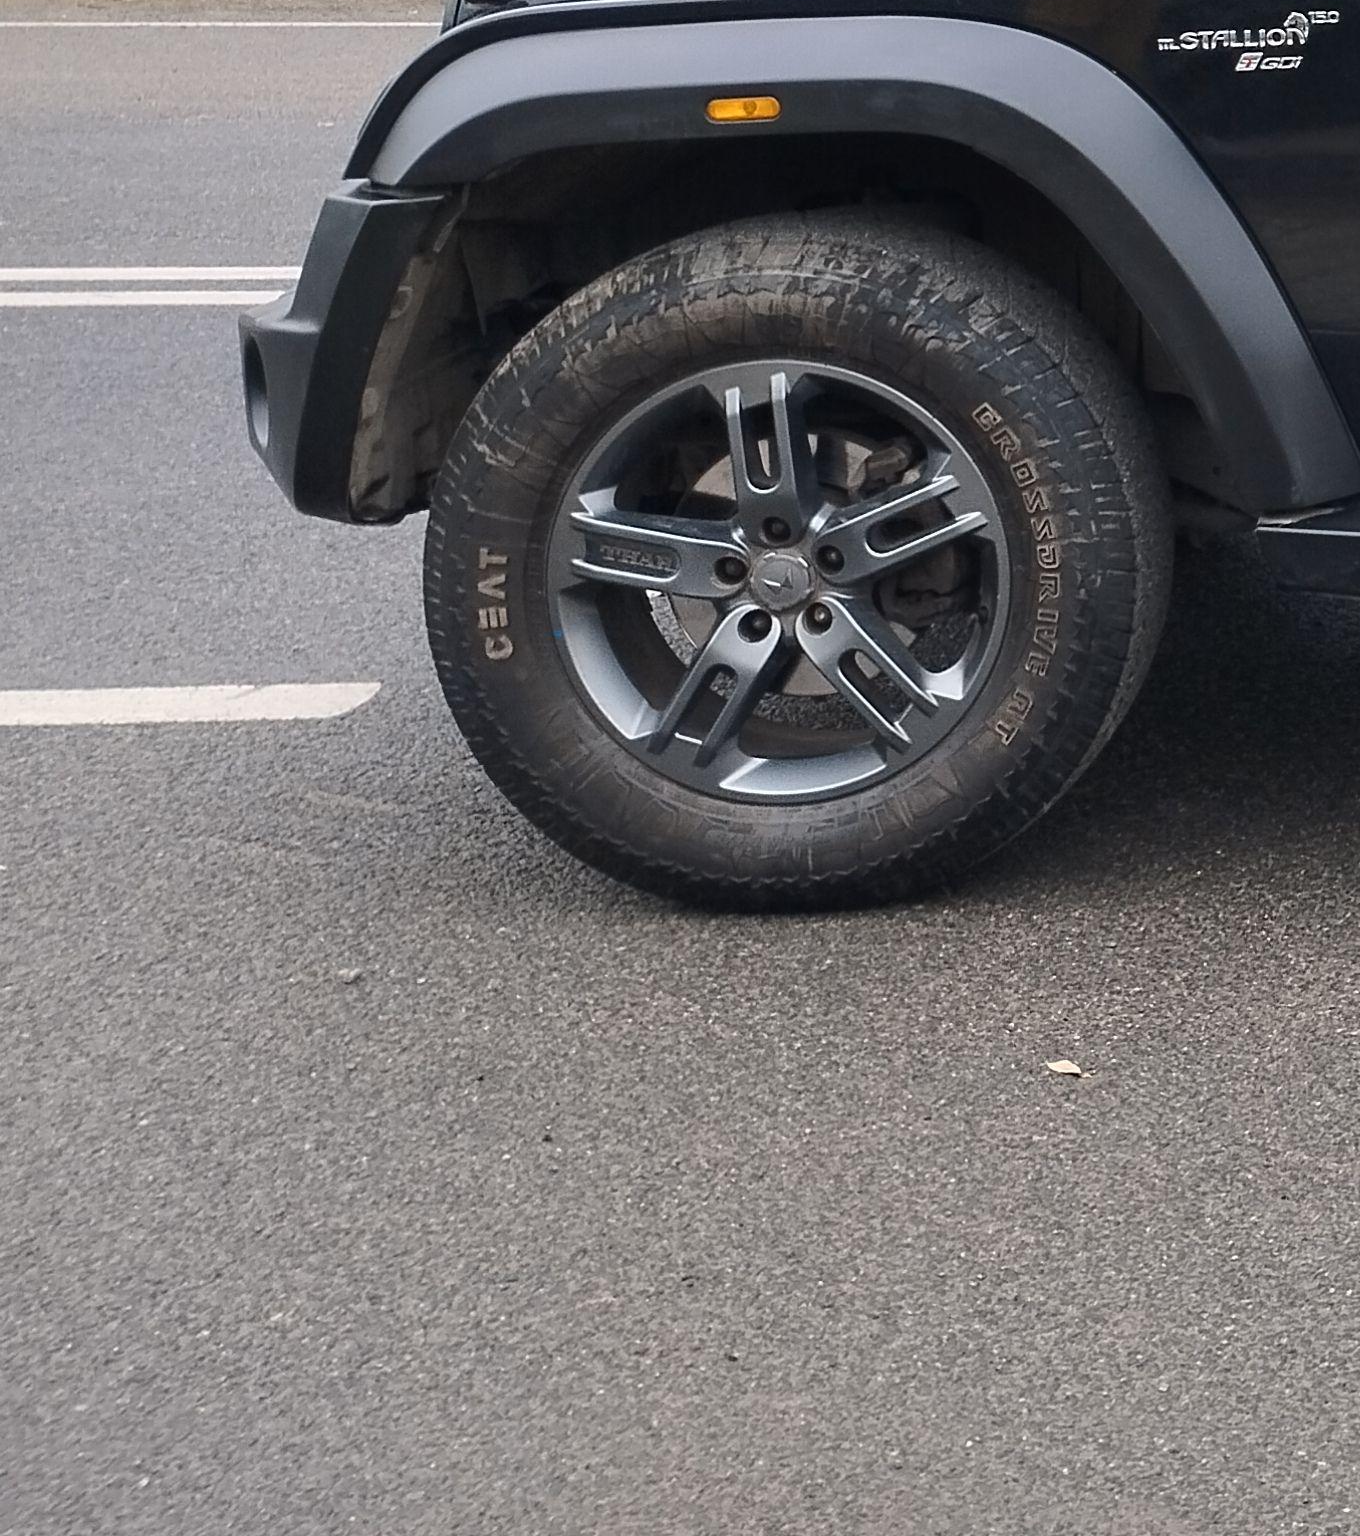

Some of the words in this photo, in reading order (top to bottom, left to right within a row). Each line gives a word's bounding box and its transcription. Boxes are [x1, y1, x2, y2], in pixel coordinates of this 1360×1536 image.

[1308, 10, 1340, 24] 150
[971, 402, 1060, 676] CROSSDRIVE
[477, 547, 514, 660] CEAT
